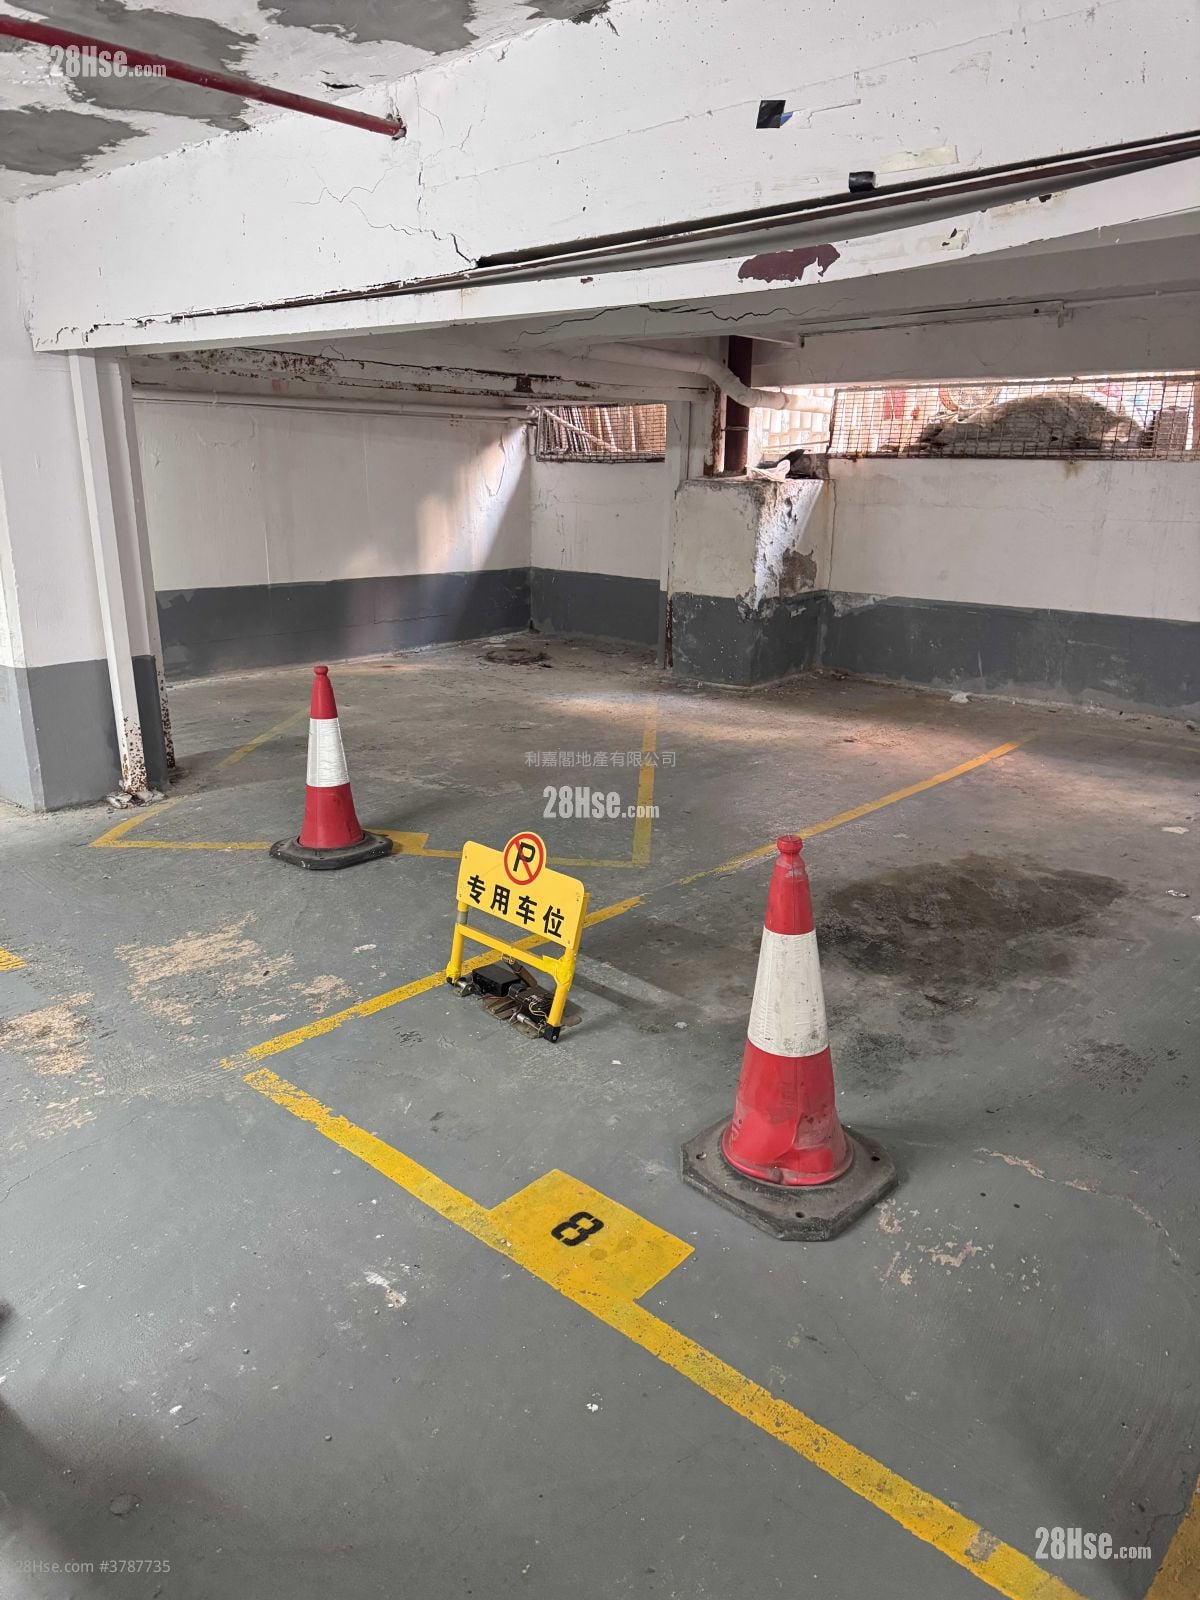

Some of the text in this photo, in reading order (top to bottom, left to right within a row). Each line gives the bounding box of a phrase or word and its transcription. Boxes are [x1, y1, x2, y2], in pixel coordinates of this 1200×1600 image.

[513, 842, 535, 872] P
[467, 874, 564, 938] 专用车位
[551, 1211, 604, 1247] 8
